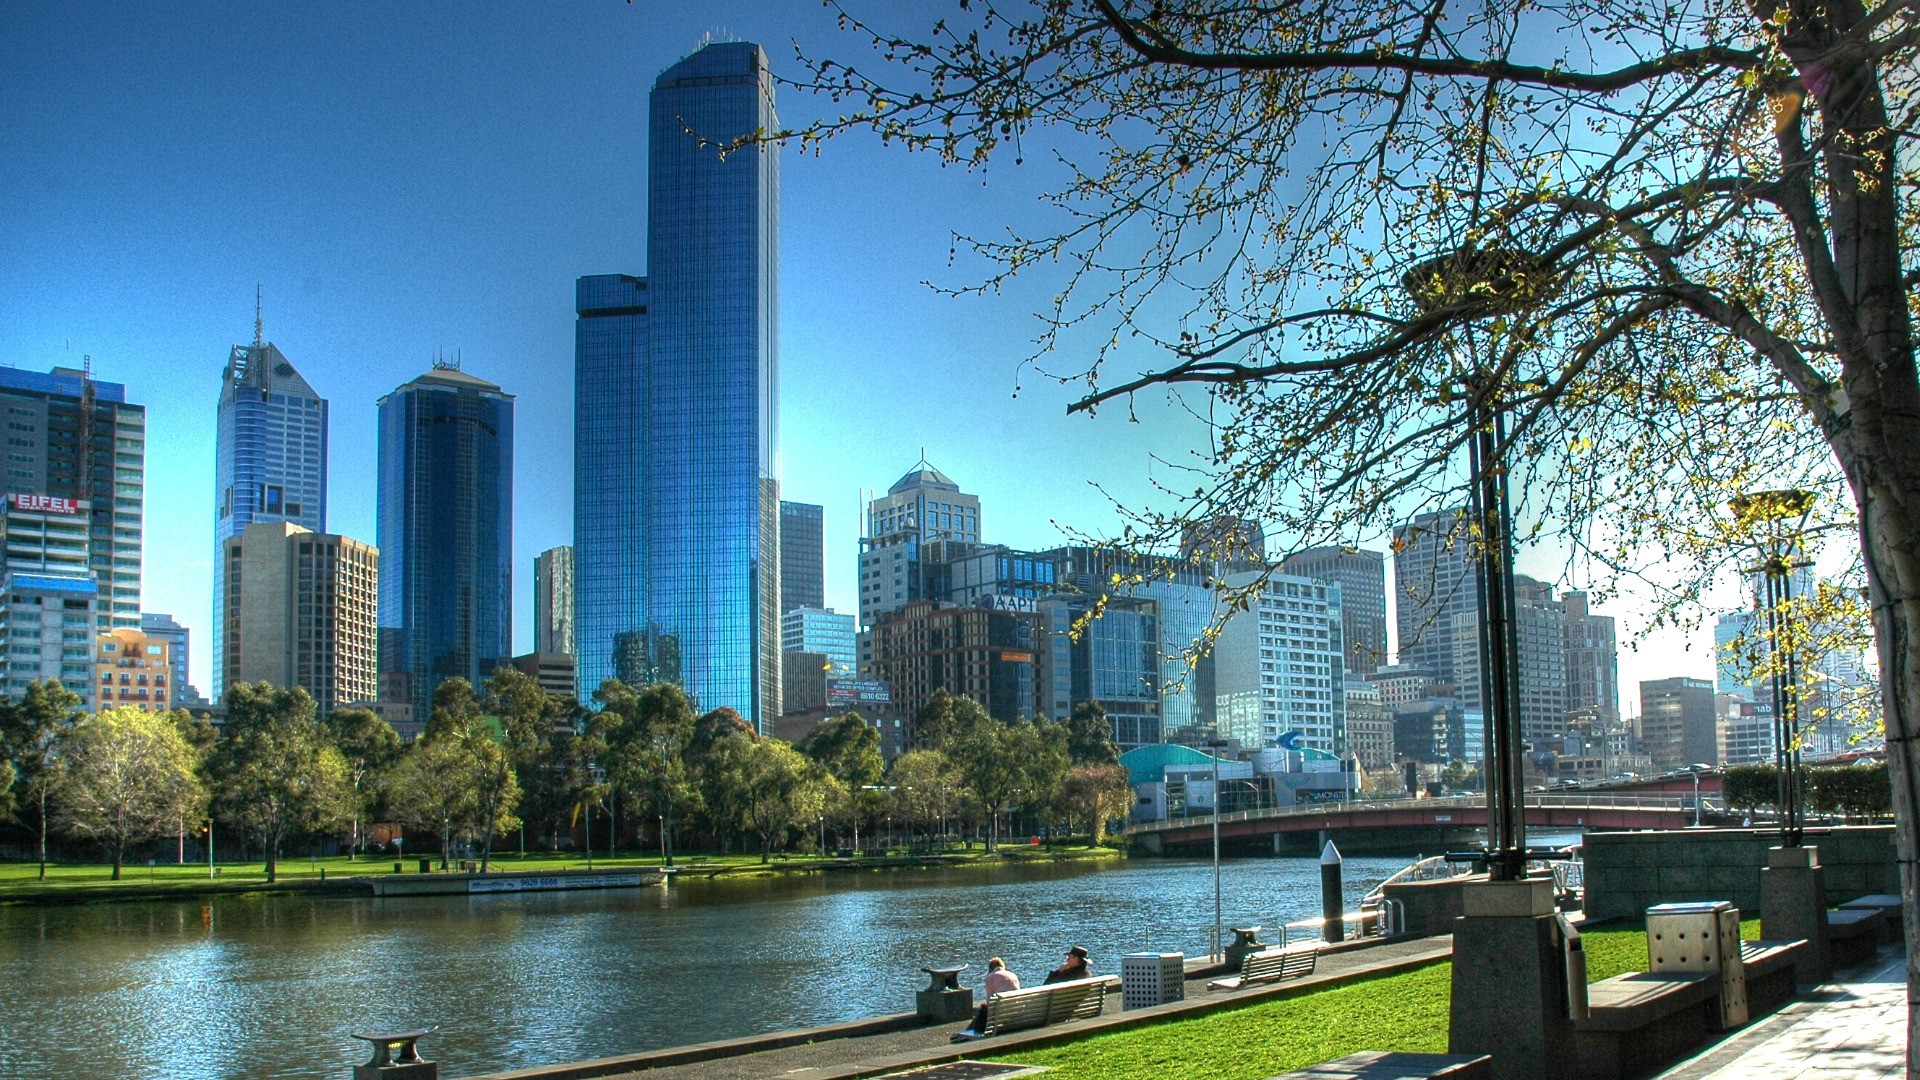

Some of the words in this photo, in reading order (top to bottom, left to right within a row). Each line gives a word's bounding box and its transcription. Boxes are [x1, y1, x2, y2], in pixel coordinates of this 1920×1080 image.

[18, 494, 75, 510] EIFEL
[18, 506, 75, 514] APARTMENTS
[995, 596, 1036, 612] AAPT
[1755, 703, 1772, 713] nab
